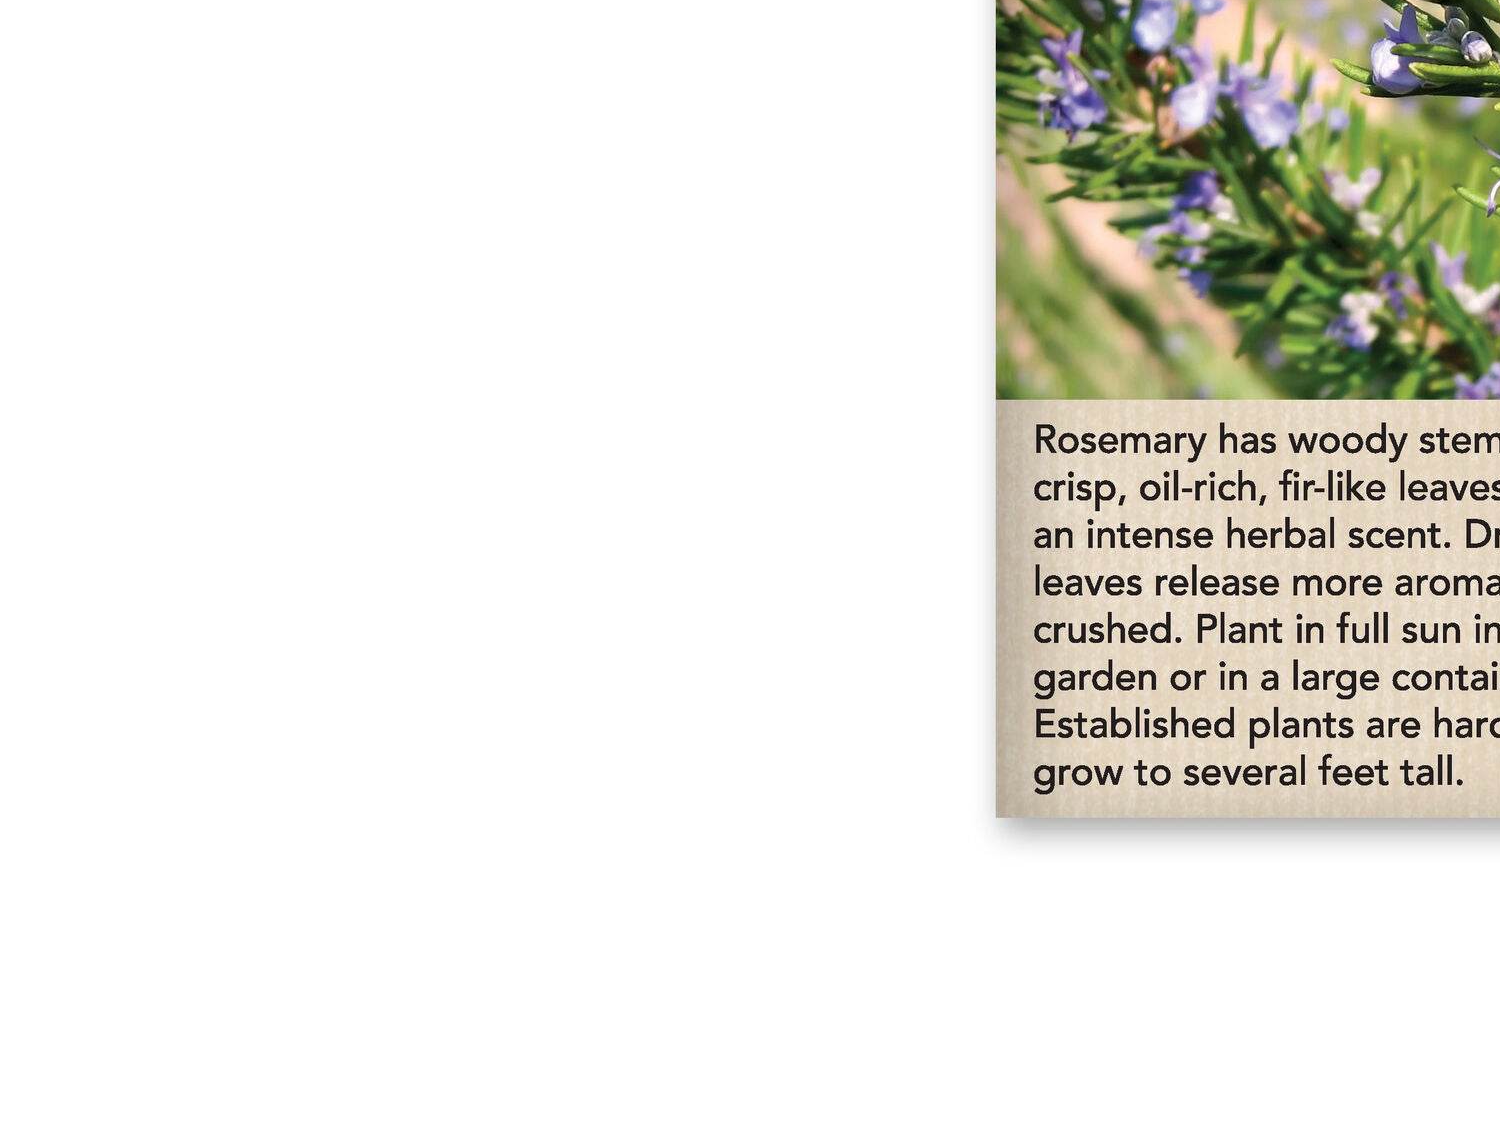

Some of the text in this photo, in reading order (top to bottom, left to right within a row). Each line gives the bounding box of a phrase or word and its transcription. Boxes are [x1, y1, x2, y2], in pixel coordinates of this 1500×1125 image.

[1036, 424, 1207, 463] Rosemary
[1220, 422, 1276, 454] has
[1288, 422, 1408, 463] woody
[1034, 471, 1125, 511] crisp,
[1140, 470, 1266, 506] oil-rich,
[1279, 469, 1385, 500] fir-like
[1034, 528, 1072, 548] an
[1088, 519, 1213, 548] intense
[1228, 517, 1334, 548] herbal
[1349, 523, 1450, 548] scent.
[1036, 564, 1142, 596] leaves
[1156, 564, 1279, 595] release
[1293, 575, 1382, 595] more
[1034, 612, 1181, 643] crushed.
[1198, 612, 1282, 643] Plant
[1297, 614, 1323, 643] in
[1337, 612, 1388, 643] full
[1402, 623, 1460, 643] sun
[1034, 659, 1156, 699] garden
[1171, 670, 1206, 690] or
[1219, 661, 1247, 690] in
[1261, 670, 1278, 691] a
[1293, 659, 1379, 699] large
[1036, 707, 1234, 738] Established
[1250, 707, 1354, 749] plants
[1367, 718, 1420, 738] are
[1034, 754, 1463, 794] grow to several feet tall.
